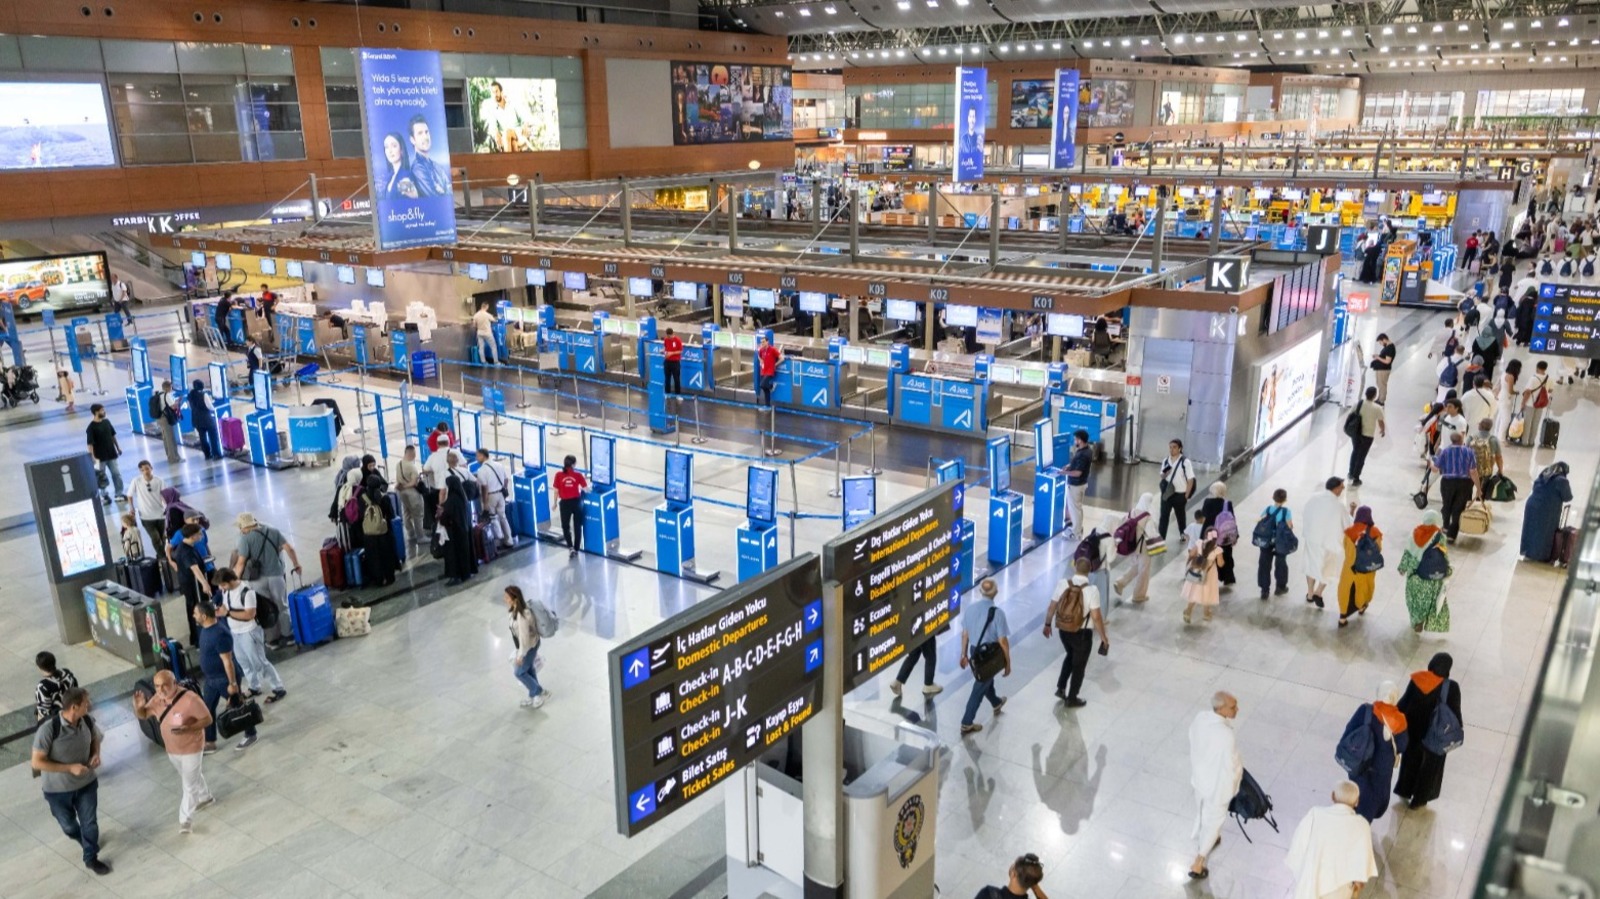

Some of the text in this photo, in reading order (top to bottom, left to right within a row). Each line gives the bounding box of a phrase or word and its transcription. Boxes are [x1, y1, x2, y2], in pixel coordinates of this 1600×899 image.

[391, 75, 396, 83] 5
[398, 75, 410, 83] kez
[372, 86, 385, 94] tek
[387, 87, 401, 96] yön
[402, 86, 419, 96] uçak
[1501, 168, 1511, 179] H
[1521, 163, 1531, 172] G
[159, 216, 174, 233] K
[388, 206, 424, 223] shop&fly
[147, 217, 156, 233] K
[1315, 229, 1327, 250] J
[604, 264, 617, 272] K07
[651, 268, 664, 276] K06
[729, 273, 743, 283] K05
[1211, 262, 1234, 288] K
[1240, 261, 1249, 287] K
[781, 277, 796, 288] K04
[868, 283, 885, 295] K03
[930, 289, 947, 300] K02
[1034, 296, 1052, 309] K01
[1567, 307, 1594, 315] Check-in
[1209, 316, 1226, 339] K
[1563, 332, 1589, 340] Check-in
[907, 379, 926, 388] AJet
[949, 385, 968, 394] AJet
[1070, 400, 1092, 411] AJet
[296, 419, 318, 427] AJet
[871, 508, 933, 549] Dış Hatlar Giden Yolcu
[871, 518, 939, 563] International Departures
[870, 531, 952, 586] Engelli Yolcu Danışma & Check-in
[870, 545, 951, 600] Disabled Information & Check-in
[933, 567, 949, 585] Yardım
[925, 583, 945, 602] First Aid
[870, 603, 891, 622] Eczane
[925, 599, 948, 622] Bilet Satış
[676, 597, 767, 653] İç Hatlar Giden Yolcu
[869, 613, 900, 637] Pharmacy
[924, 611, 949, 635] Ticket Sales
[677, 614, 768, 670] Domestic Departures
[869, 636, 896, 659] Danışma
[679, 622, 803, 696] Check-in A-B-C-D-E-F-G-H
[869, 644, 904, 672] Information
[679, 686, 720, 714] Check-in
[680, 695, 748, 739] Check-in J-K
[765, 696, 804, 732] Kayıp Eşya
[766, 704, 812, 746] Lost & Found
[681, 728, 721, 757] Check-in
[682, 747, 727, 783] Bilet Satış
[682, 760, 735, 799] Ticket Sales
